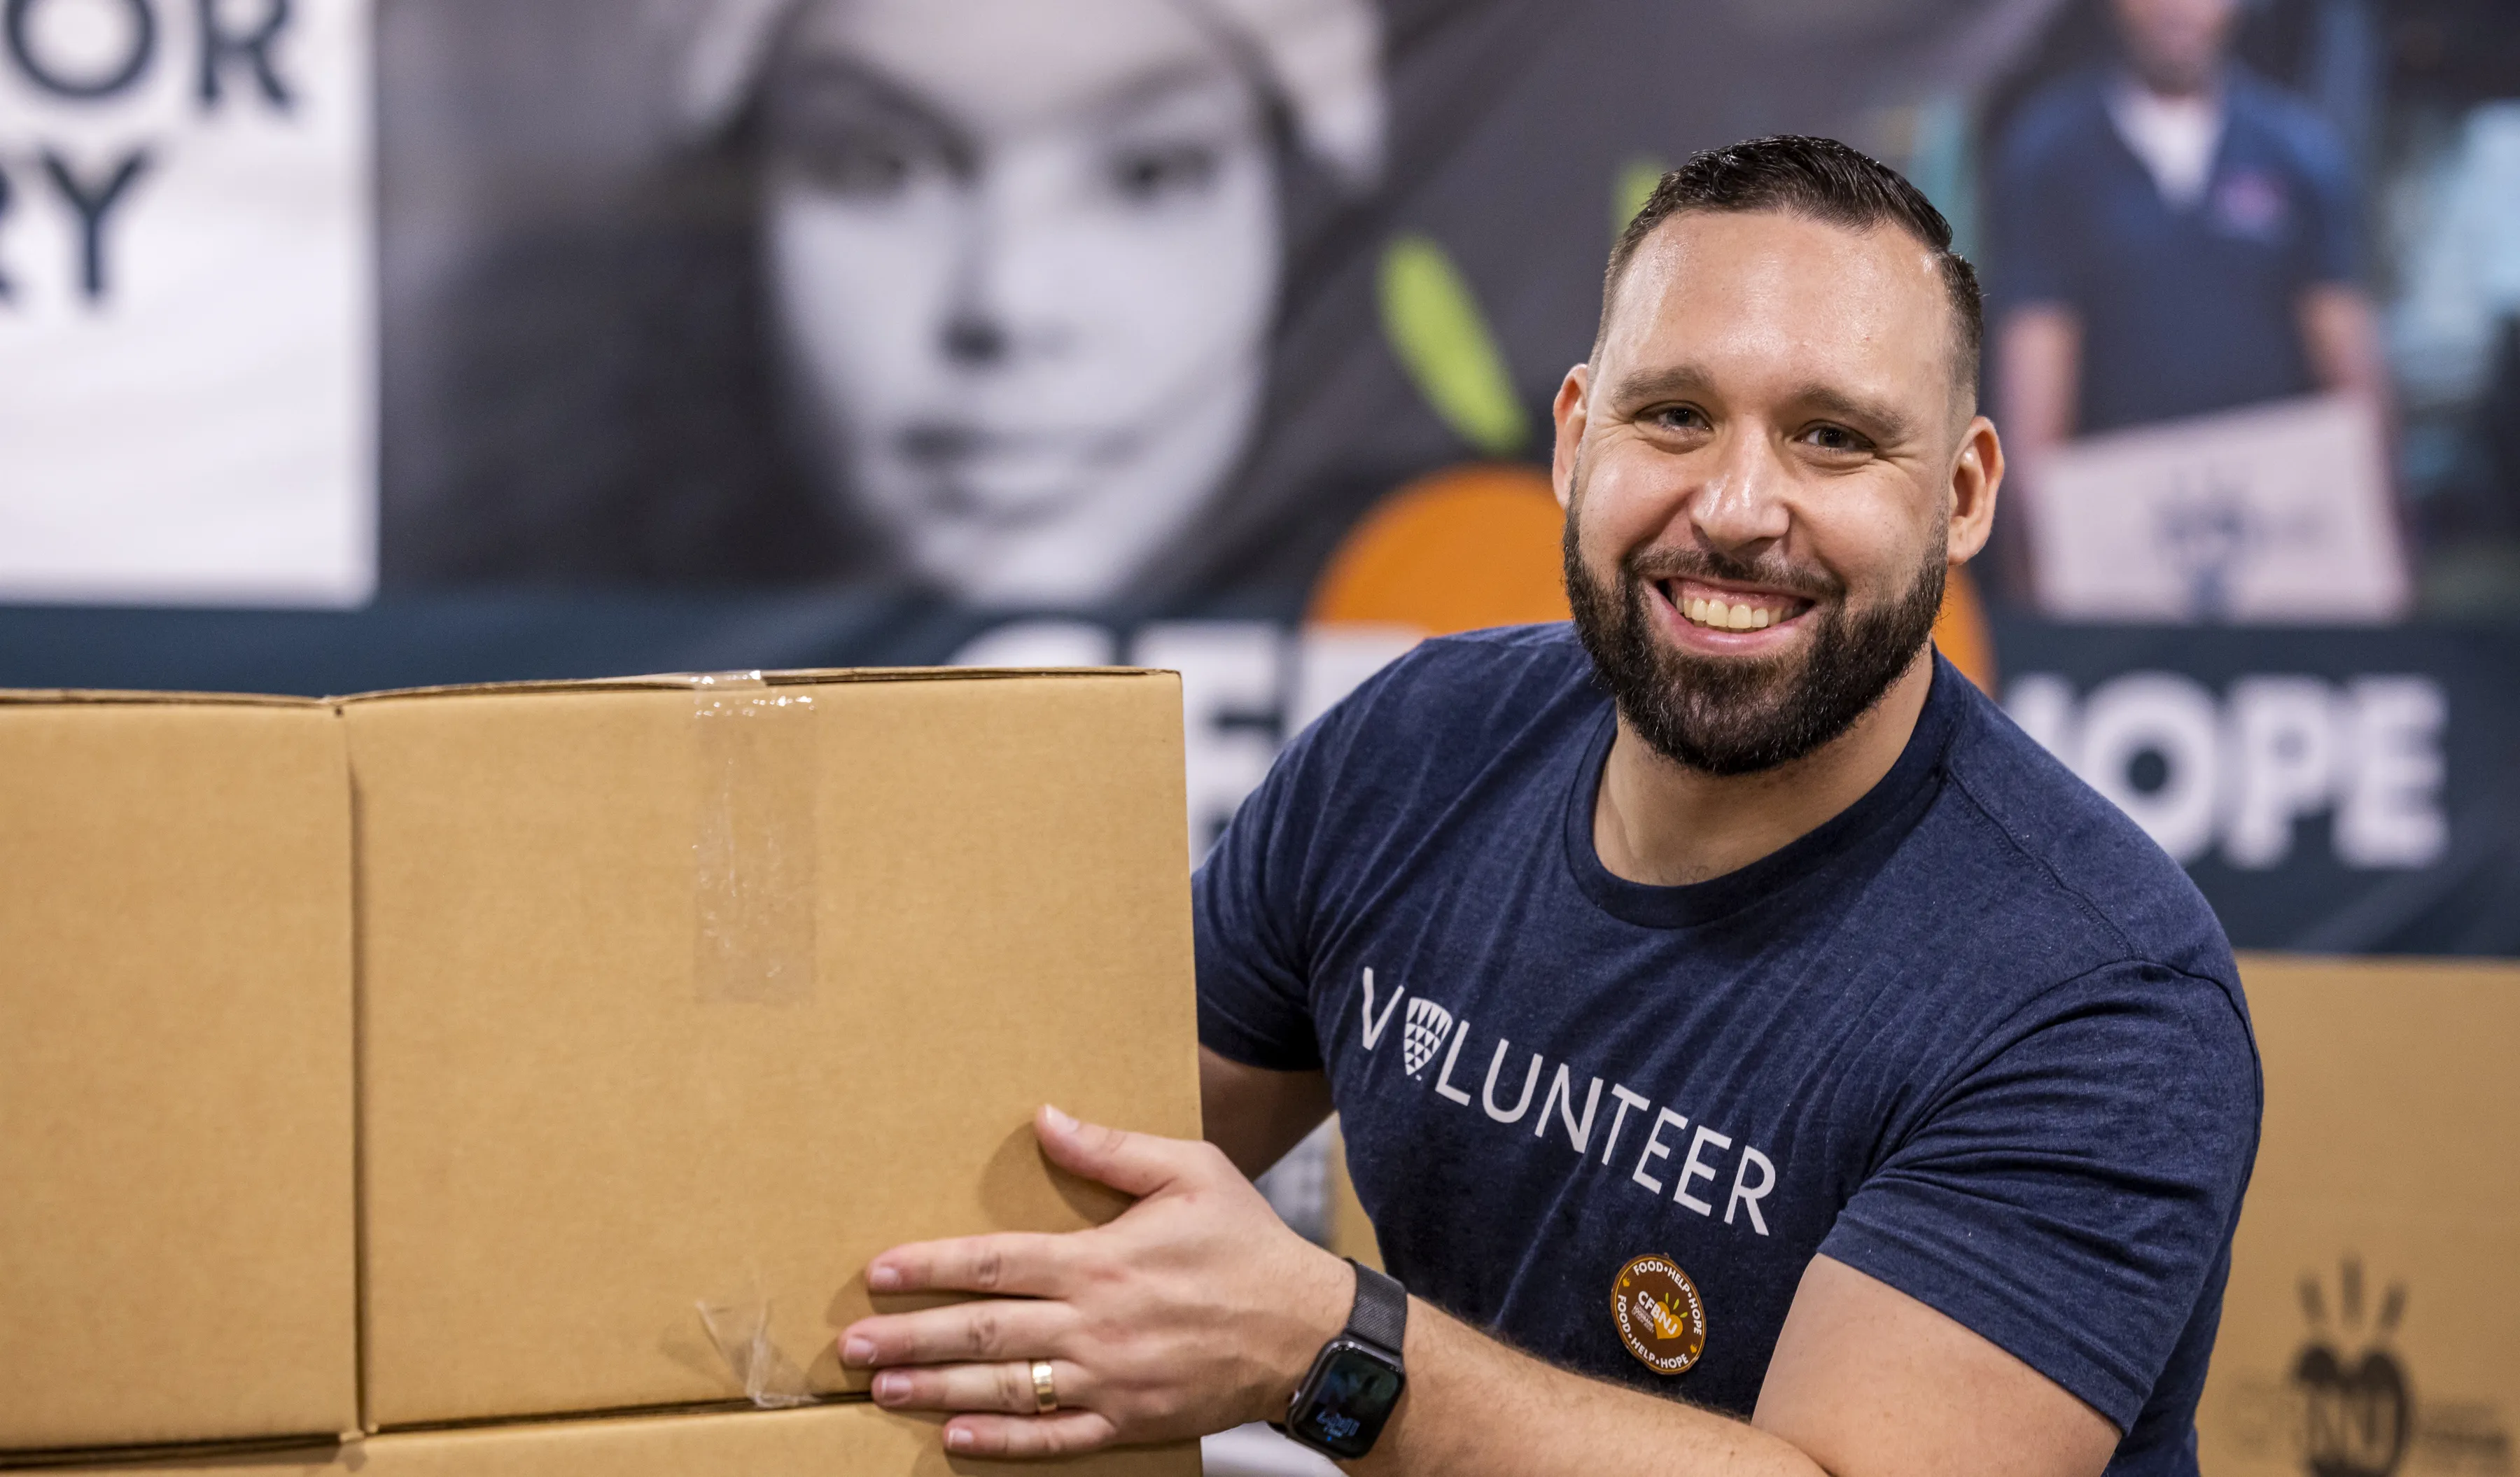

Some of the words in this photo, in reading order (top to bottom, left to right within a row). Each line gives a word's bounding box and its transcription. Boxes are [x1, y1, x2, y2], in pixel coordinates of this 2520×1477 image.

[0, 144, 151, 302] Y
[1618, 1294, 1631, 1334] FOOD
[1631, 1336, 1656, 1361] HELP
[1660, 1353, 1689, 1368] HOPE
[1633, 1261, 1663, 1275] FOOD
[1667, 1267, 1690, 1292] HELP
[1688, 1297, 1702, 1336] HOPE
[1638, 1291, 1678, 1335] CFBNJ
